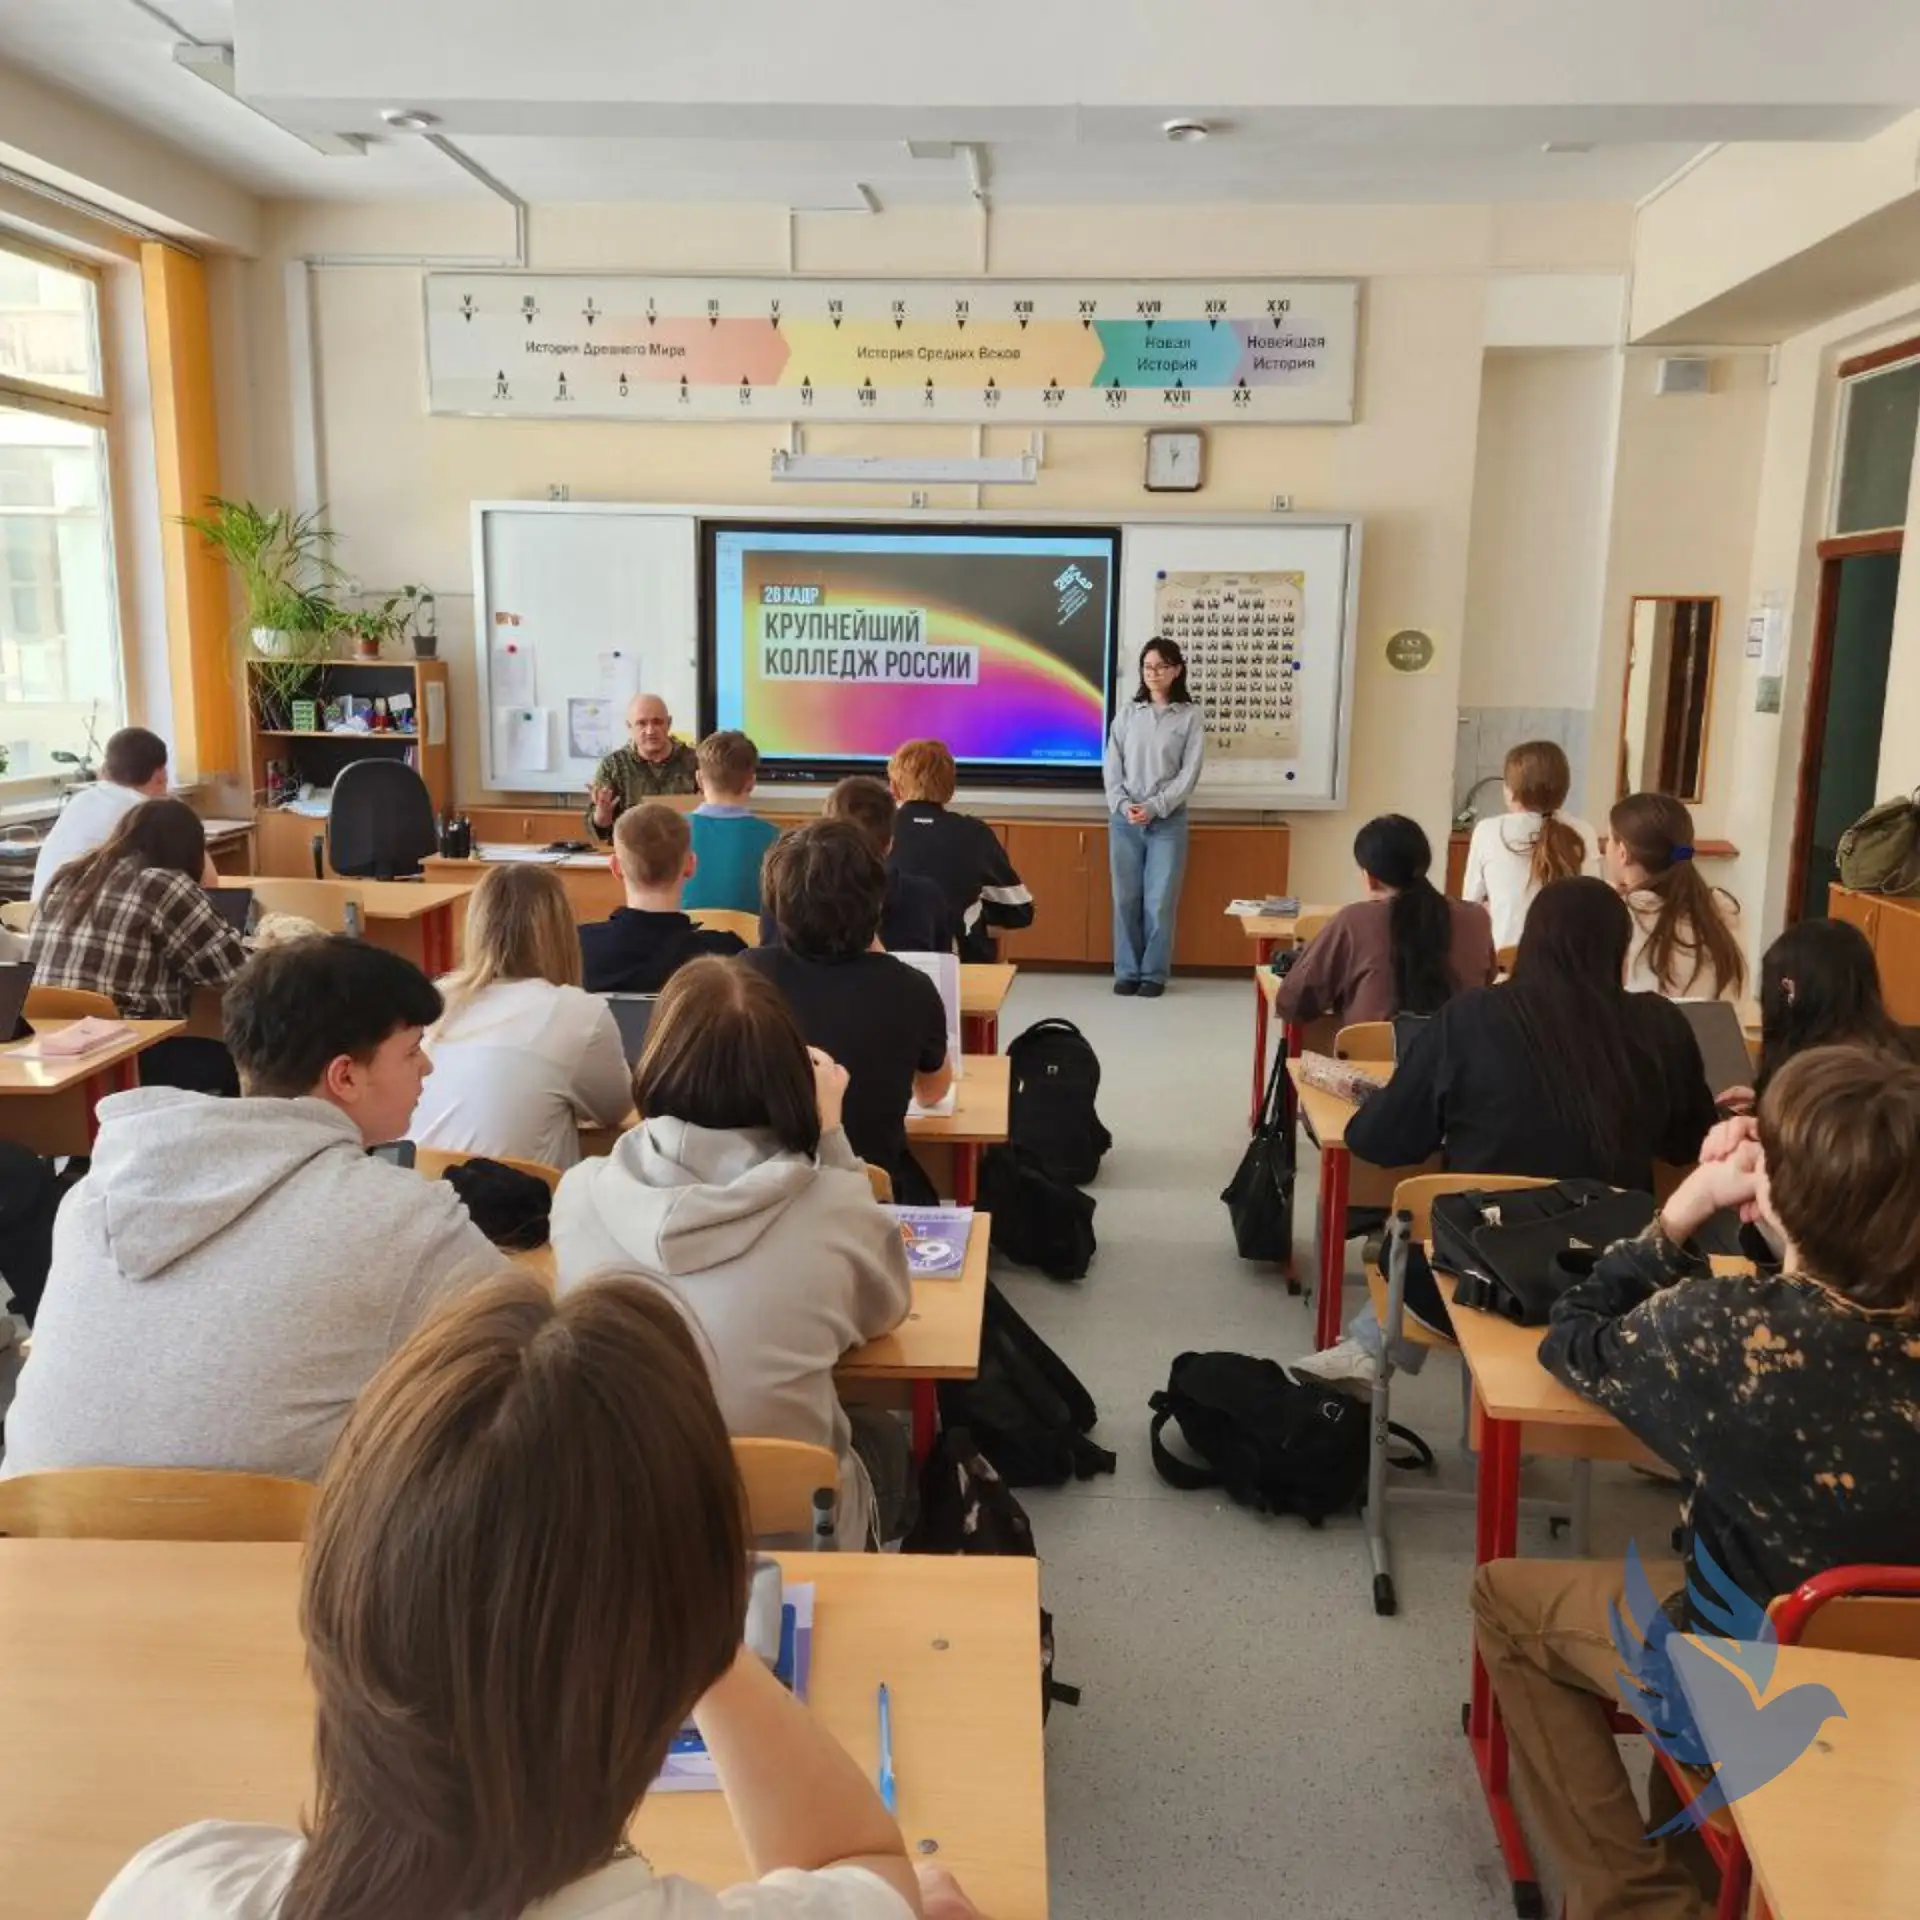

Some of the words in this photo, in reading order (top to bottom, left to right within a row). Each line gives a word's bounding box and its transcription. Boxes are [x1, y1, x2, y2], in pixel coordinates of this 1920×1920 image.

[892, 300, 905, 312] IX
[955, 300, 969, 312] XI
[1078, 300, 1096, 312] XV
[1136, 300, 1161, 312] XVII
[1205, 300, 1226, 312] XIX
[1267, 299, 1290, 312] XXI
[1145, 335, 1191, 349] Новая
[1247, 333, 1326, 349] Новейшая
[525, 340, 579, 355] История
[583, 341, 646, 356] Древнего
[649, 343, 686, 358] Мира
[857, 346, 914, 361] История
[917, 347, 974, 361] Средних
[979, 346, 1021, 360] Веков
[1137, 357, 1198, 373] История
[1253, 357, 1315, 373] История
[497, 382, 509, 394] IV
[739, 387, 751, 399] IV
[801, 388, 813, 400] VI
[857, 389, 876, 401] VIII
[1043, 390, 1065, 402] XIV
[1106, 390, 1127, 402] XVI
[1233, 389, 1252, 402] XX
[764, 586, 782, 603] 26
[784, 587, 819, 604] КАДР
[765, 608, 920, 643] КРУПНЕЙШИЙ
[765, 648, 879, 680] КОЛЛЕДЖ
[885, 650, 971, 679] РОССИИ
